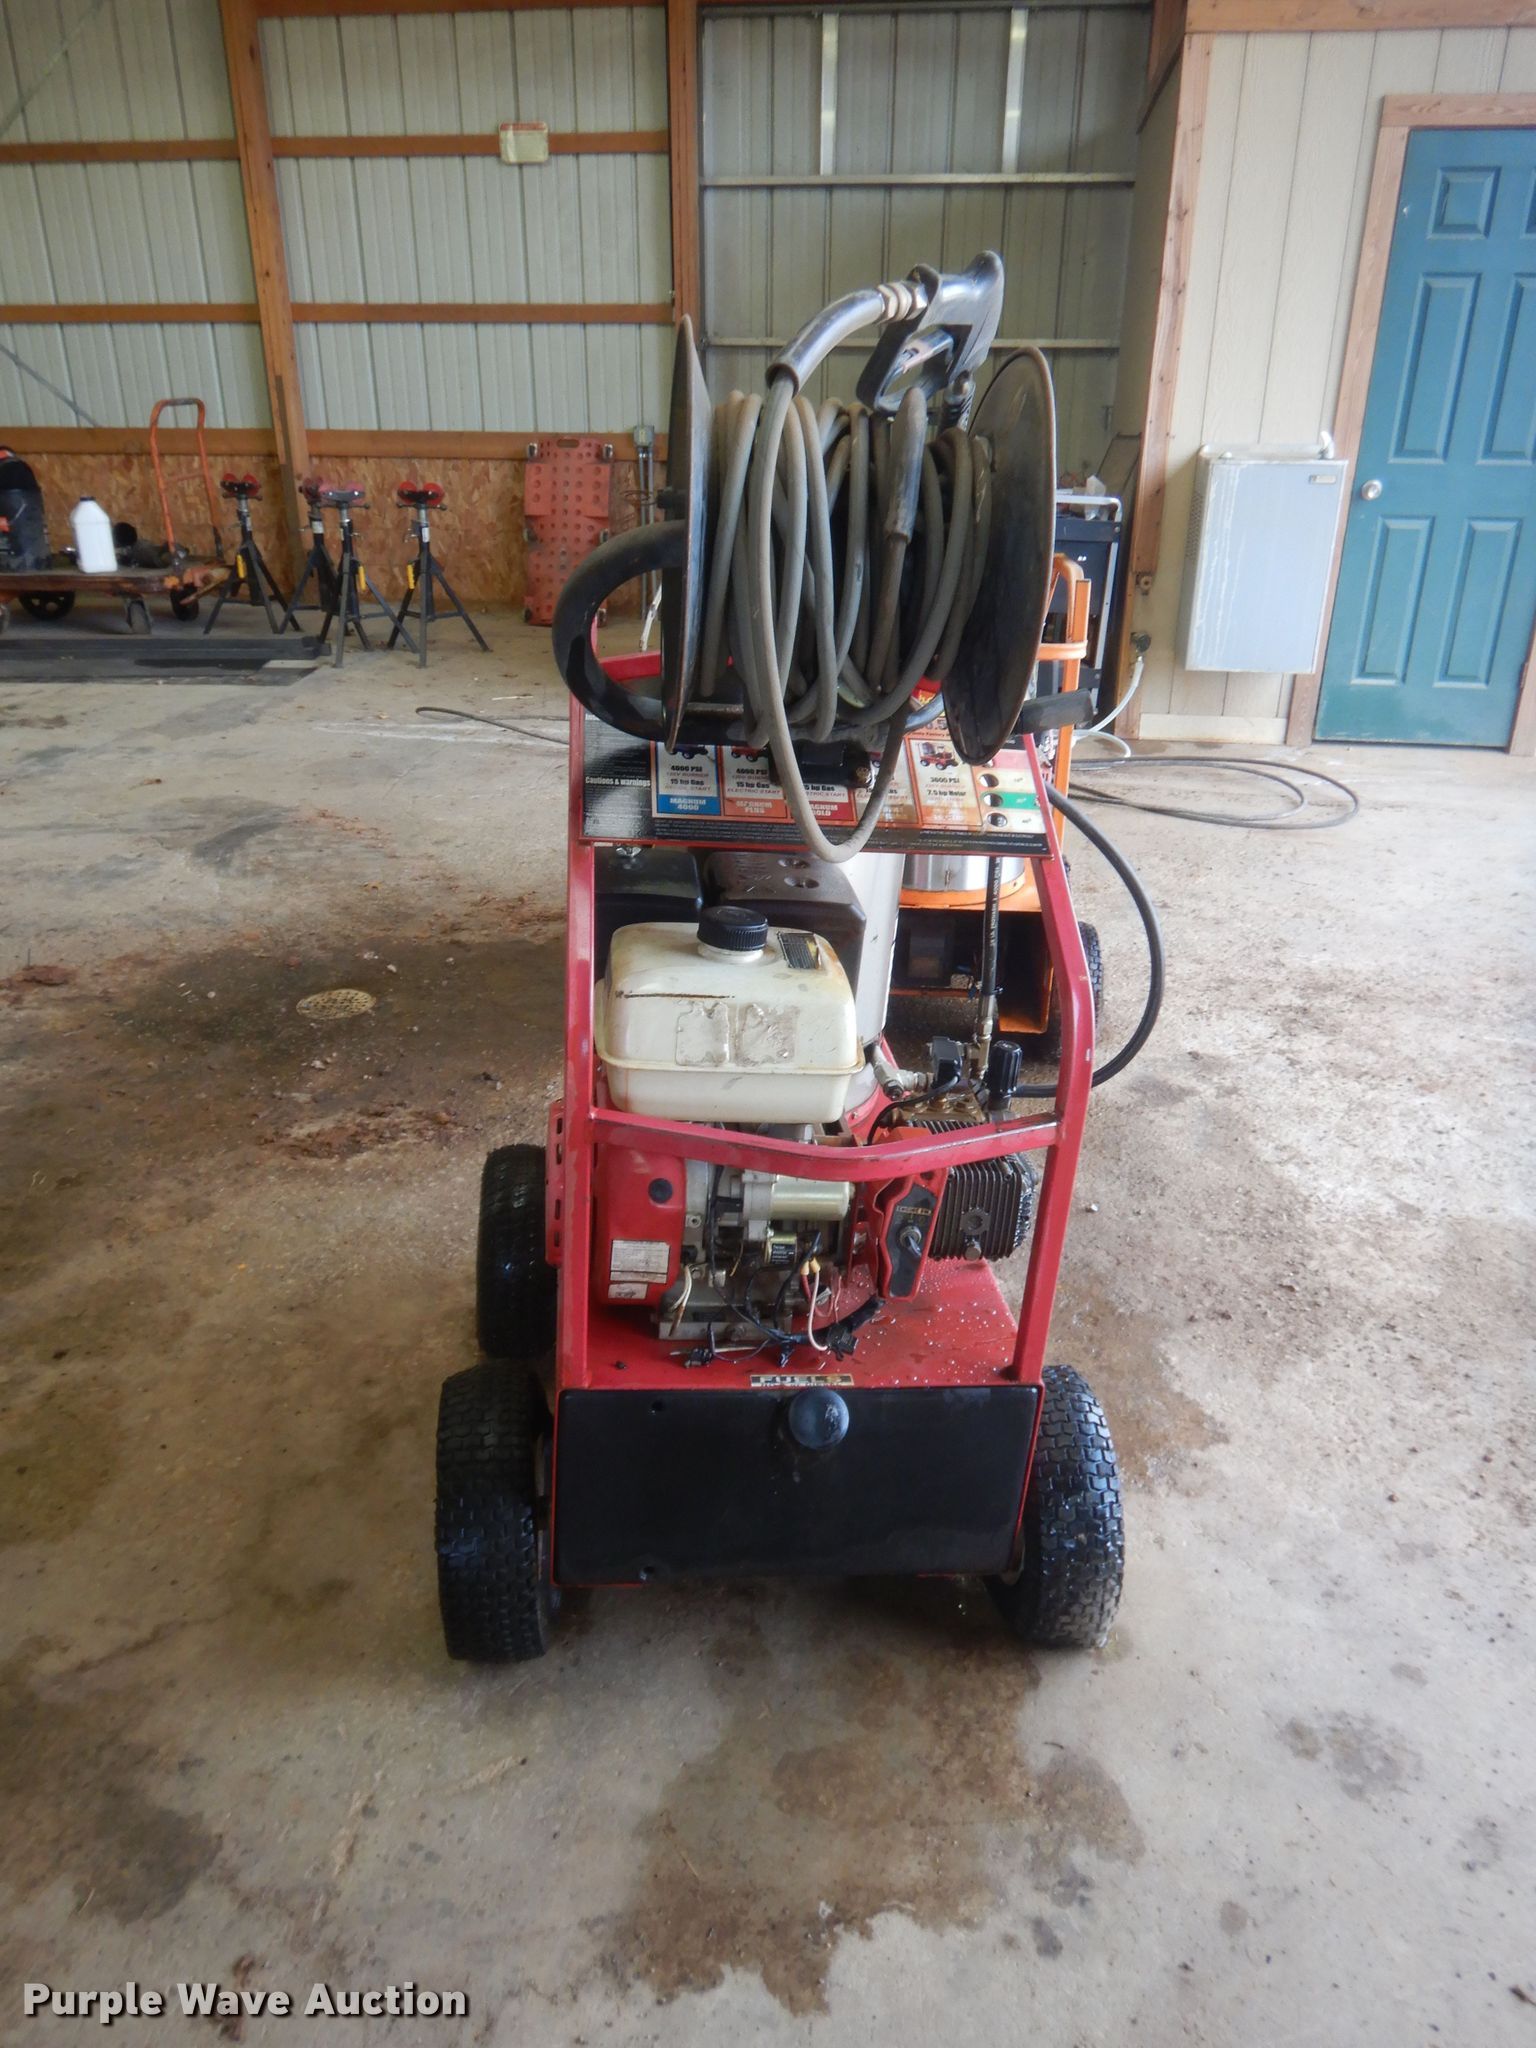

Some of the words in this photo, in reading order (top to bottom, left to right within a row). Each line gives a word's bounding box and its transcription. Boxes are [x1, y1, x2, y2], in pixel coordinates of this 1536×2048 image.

[585, 776, 614, 785] Cautions
[620, 778, 651, 787] warnings
[811, 803, 838, 811] AGNUM
